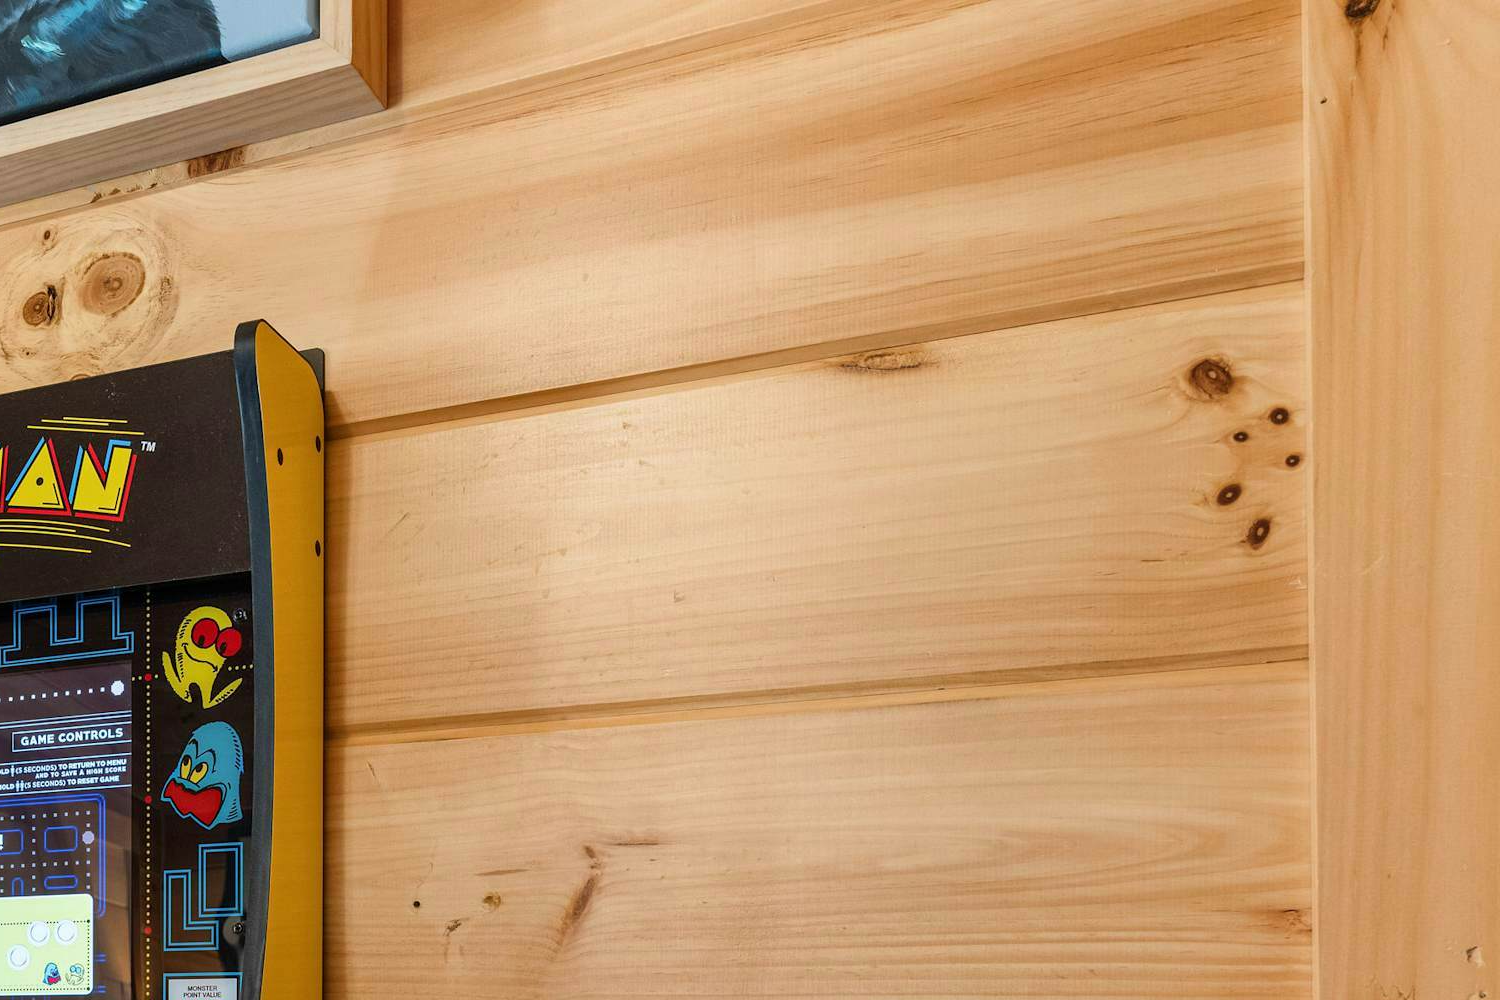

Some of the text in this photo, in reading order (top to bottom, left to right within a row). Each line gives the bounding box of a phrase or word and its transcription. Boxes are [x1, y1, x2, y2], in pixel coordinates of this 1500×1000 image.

[20, 728, 124, 746] GAME CONTROLS
[23, 764, 57, 773] SECONDS)
[58, 763, 68, 771] TO
[68, 761, 96, 769] RETURN
[106, 758, 127, 766] MENU
[104, 766, 127, 774] SCORE
[32, 779, 66, 788] SECONDS)
[67, 778, 77, 786] TO
[77, 777, 99, 785] RESET
[100, 775, 120, 783] GAME
